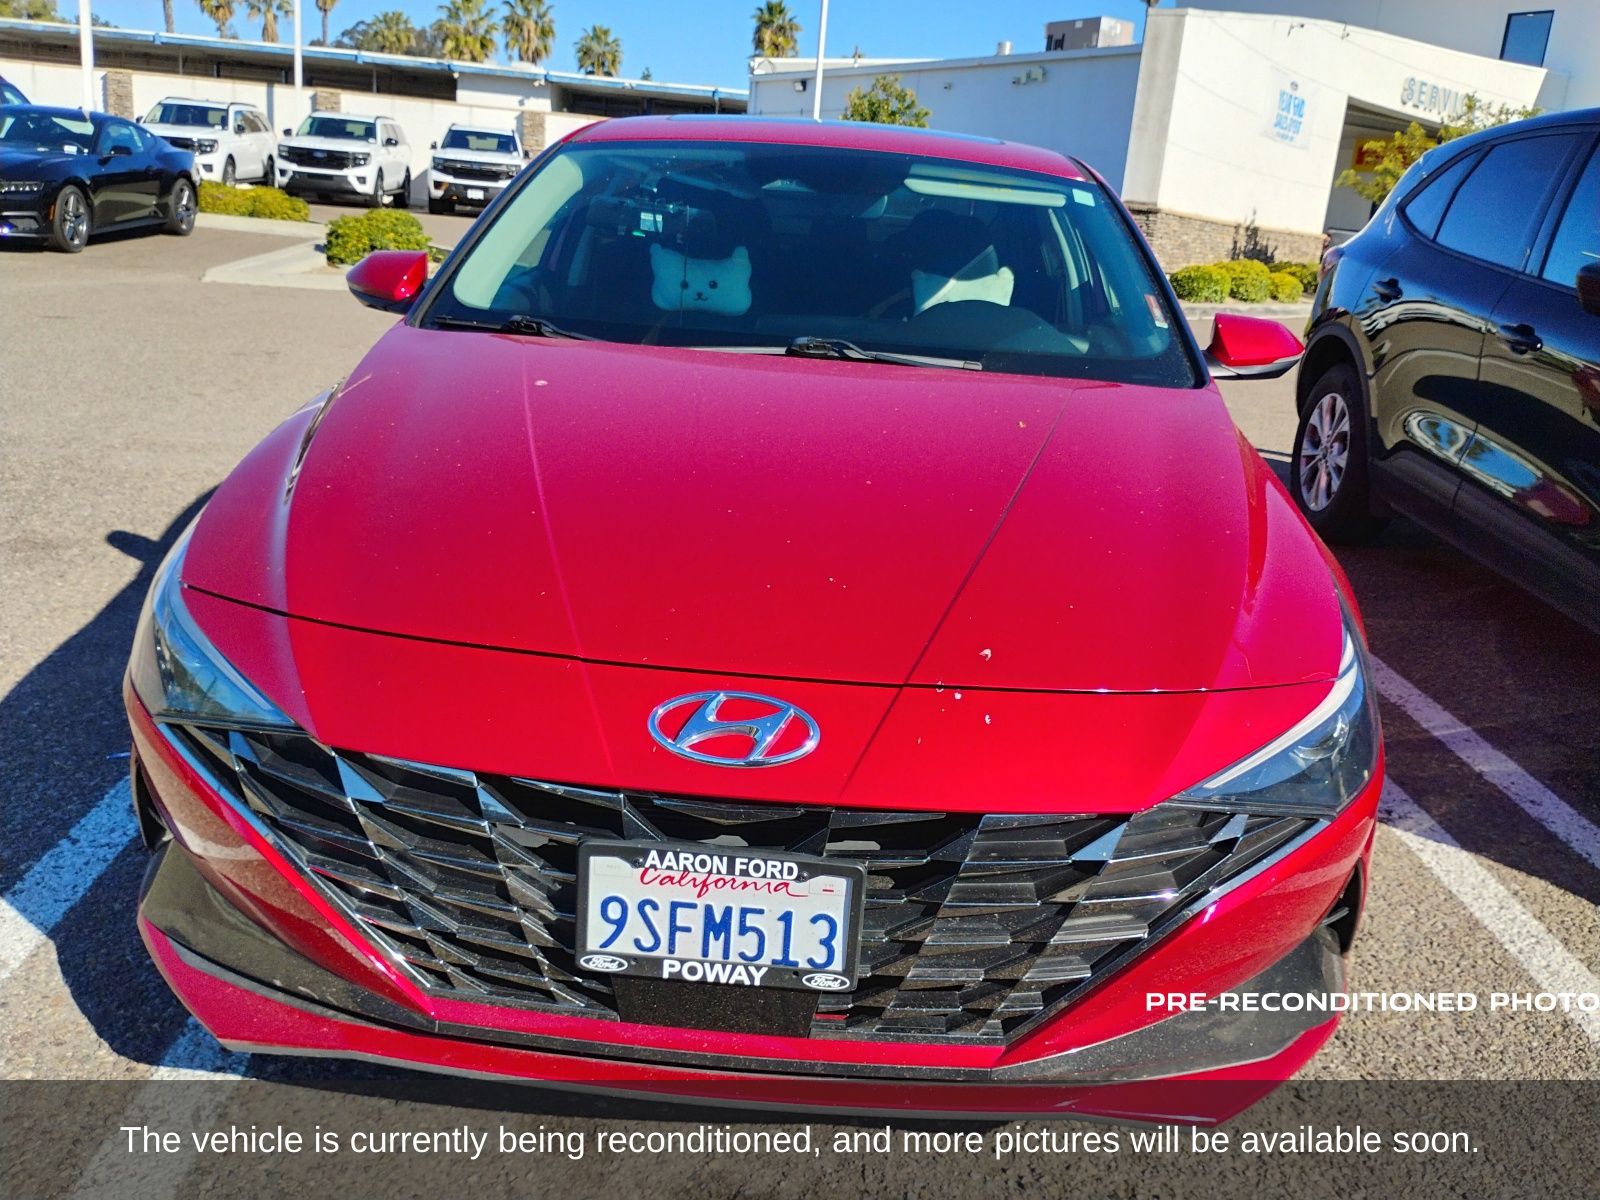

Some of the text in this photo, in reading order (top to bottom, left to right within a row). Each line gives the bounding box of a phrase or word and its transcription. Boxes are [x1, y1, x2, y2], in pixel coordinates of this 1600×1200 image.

[644, 850, 799, 881] AARON FORD
[640, 867, 809, 898] California
[599, 895, 838, 970] 9SFM513
[662, 959, 769, 987] POWAY
